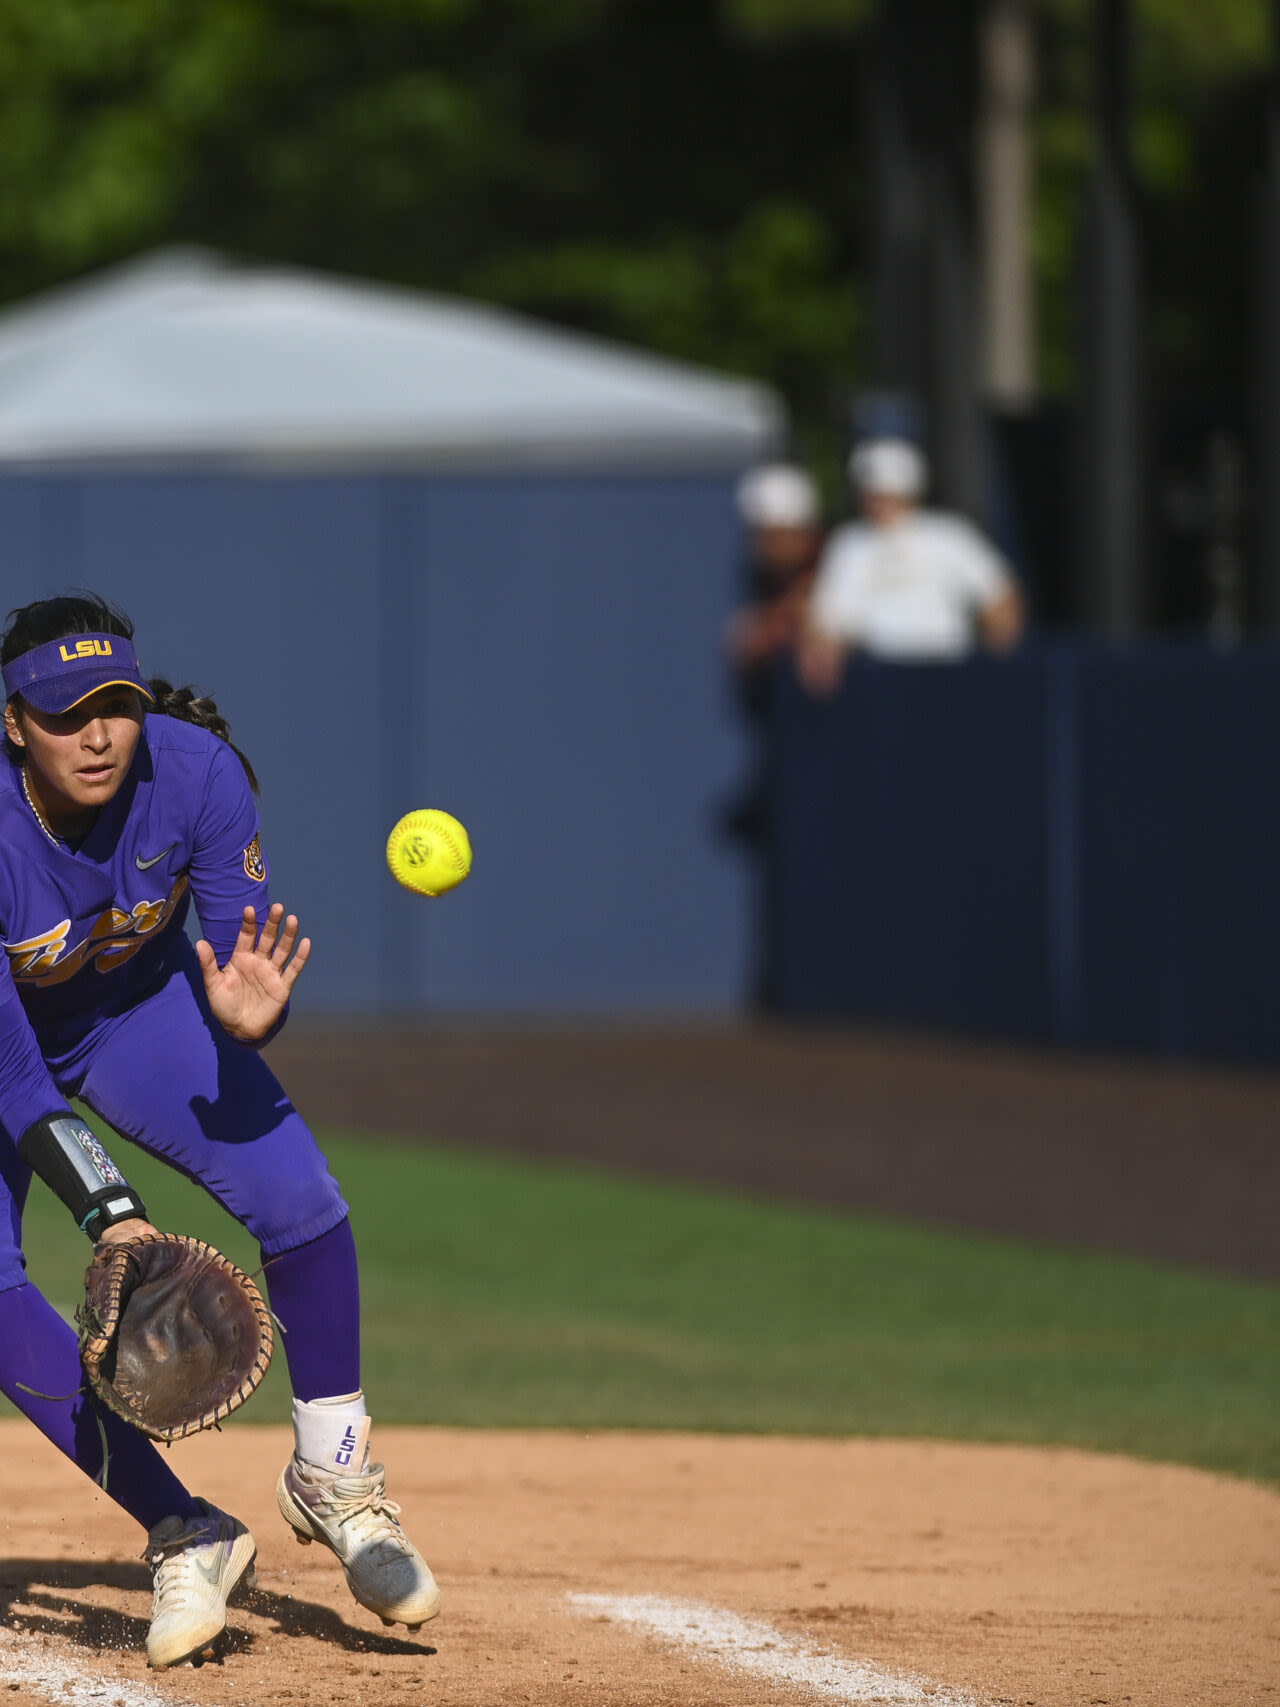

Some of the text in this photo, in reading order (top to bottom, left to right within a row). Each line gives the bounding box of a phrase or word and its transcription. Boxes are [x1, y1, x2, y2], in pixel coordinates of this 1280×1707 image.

[59, 640, 113, 662] LSU
[0, 872, 188, 988] Tiger
[335, 1425, 356, 1466] LSU
